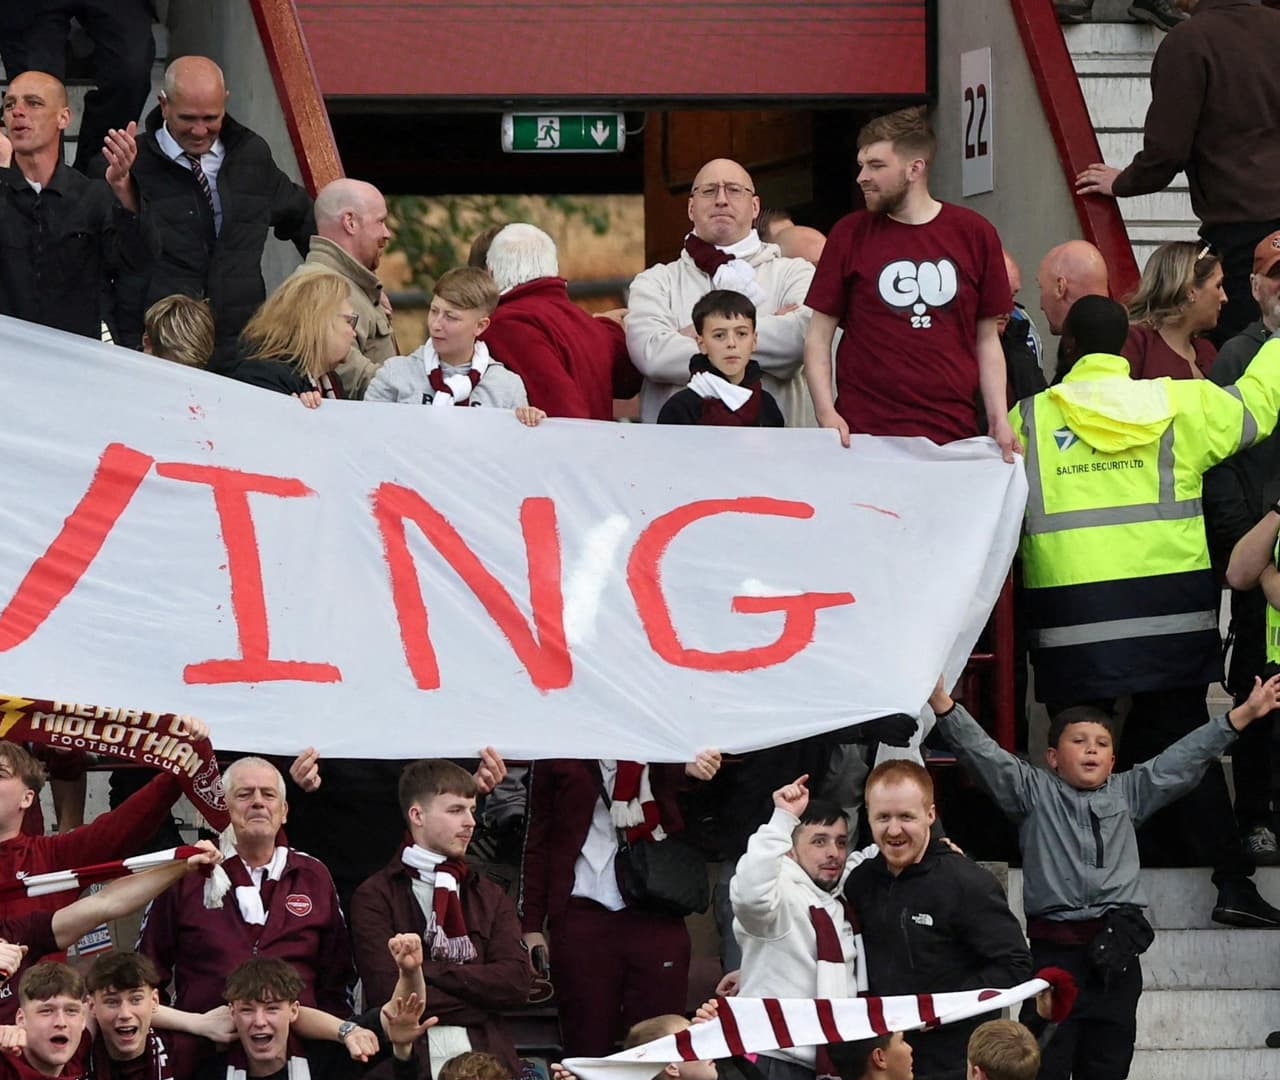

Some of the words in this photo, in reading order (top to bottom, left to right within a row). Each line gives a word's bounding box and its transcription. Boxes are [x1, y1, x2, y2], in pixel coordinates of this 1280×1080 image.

[965, 84, 987, 159] 22
[878, 259, 958, 307] GU
[910, 315, 933, 328] 22
[1056, 463, 1089, 475] SALTIRE
[1091, 460, 1129, 472] SECURITY
[1130, 459, 1144, 469] LTD
[30, 711, 204, 778] MIDLOTHIAN
[51, 734, 137, 759] FOOTBALL
[143, 754, 181, 775] CLUB
